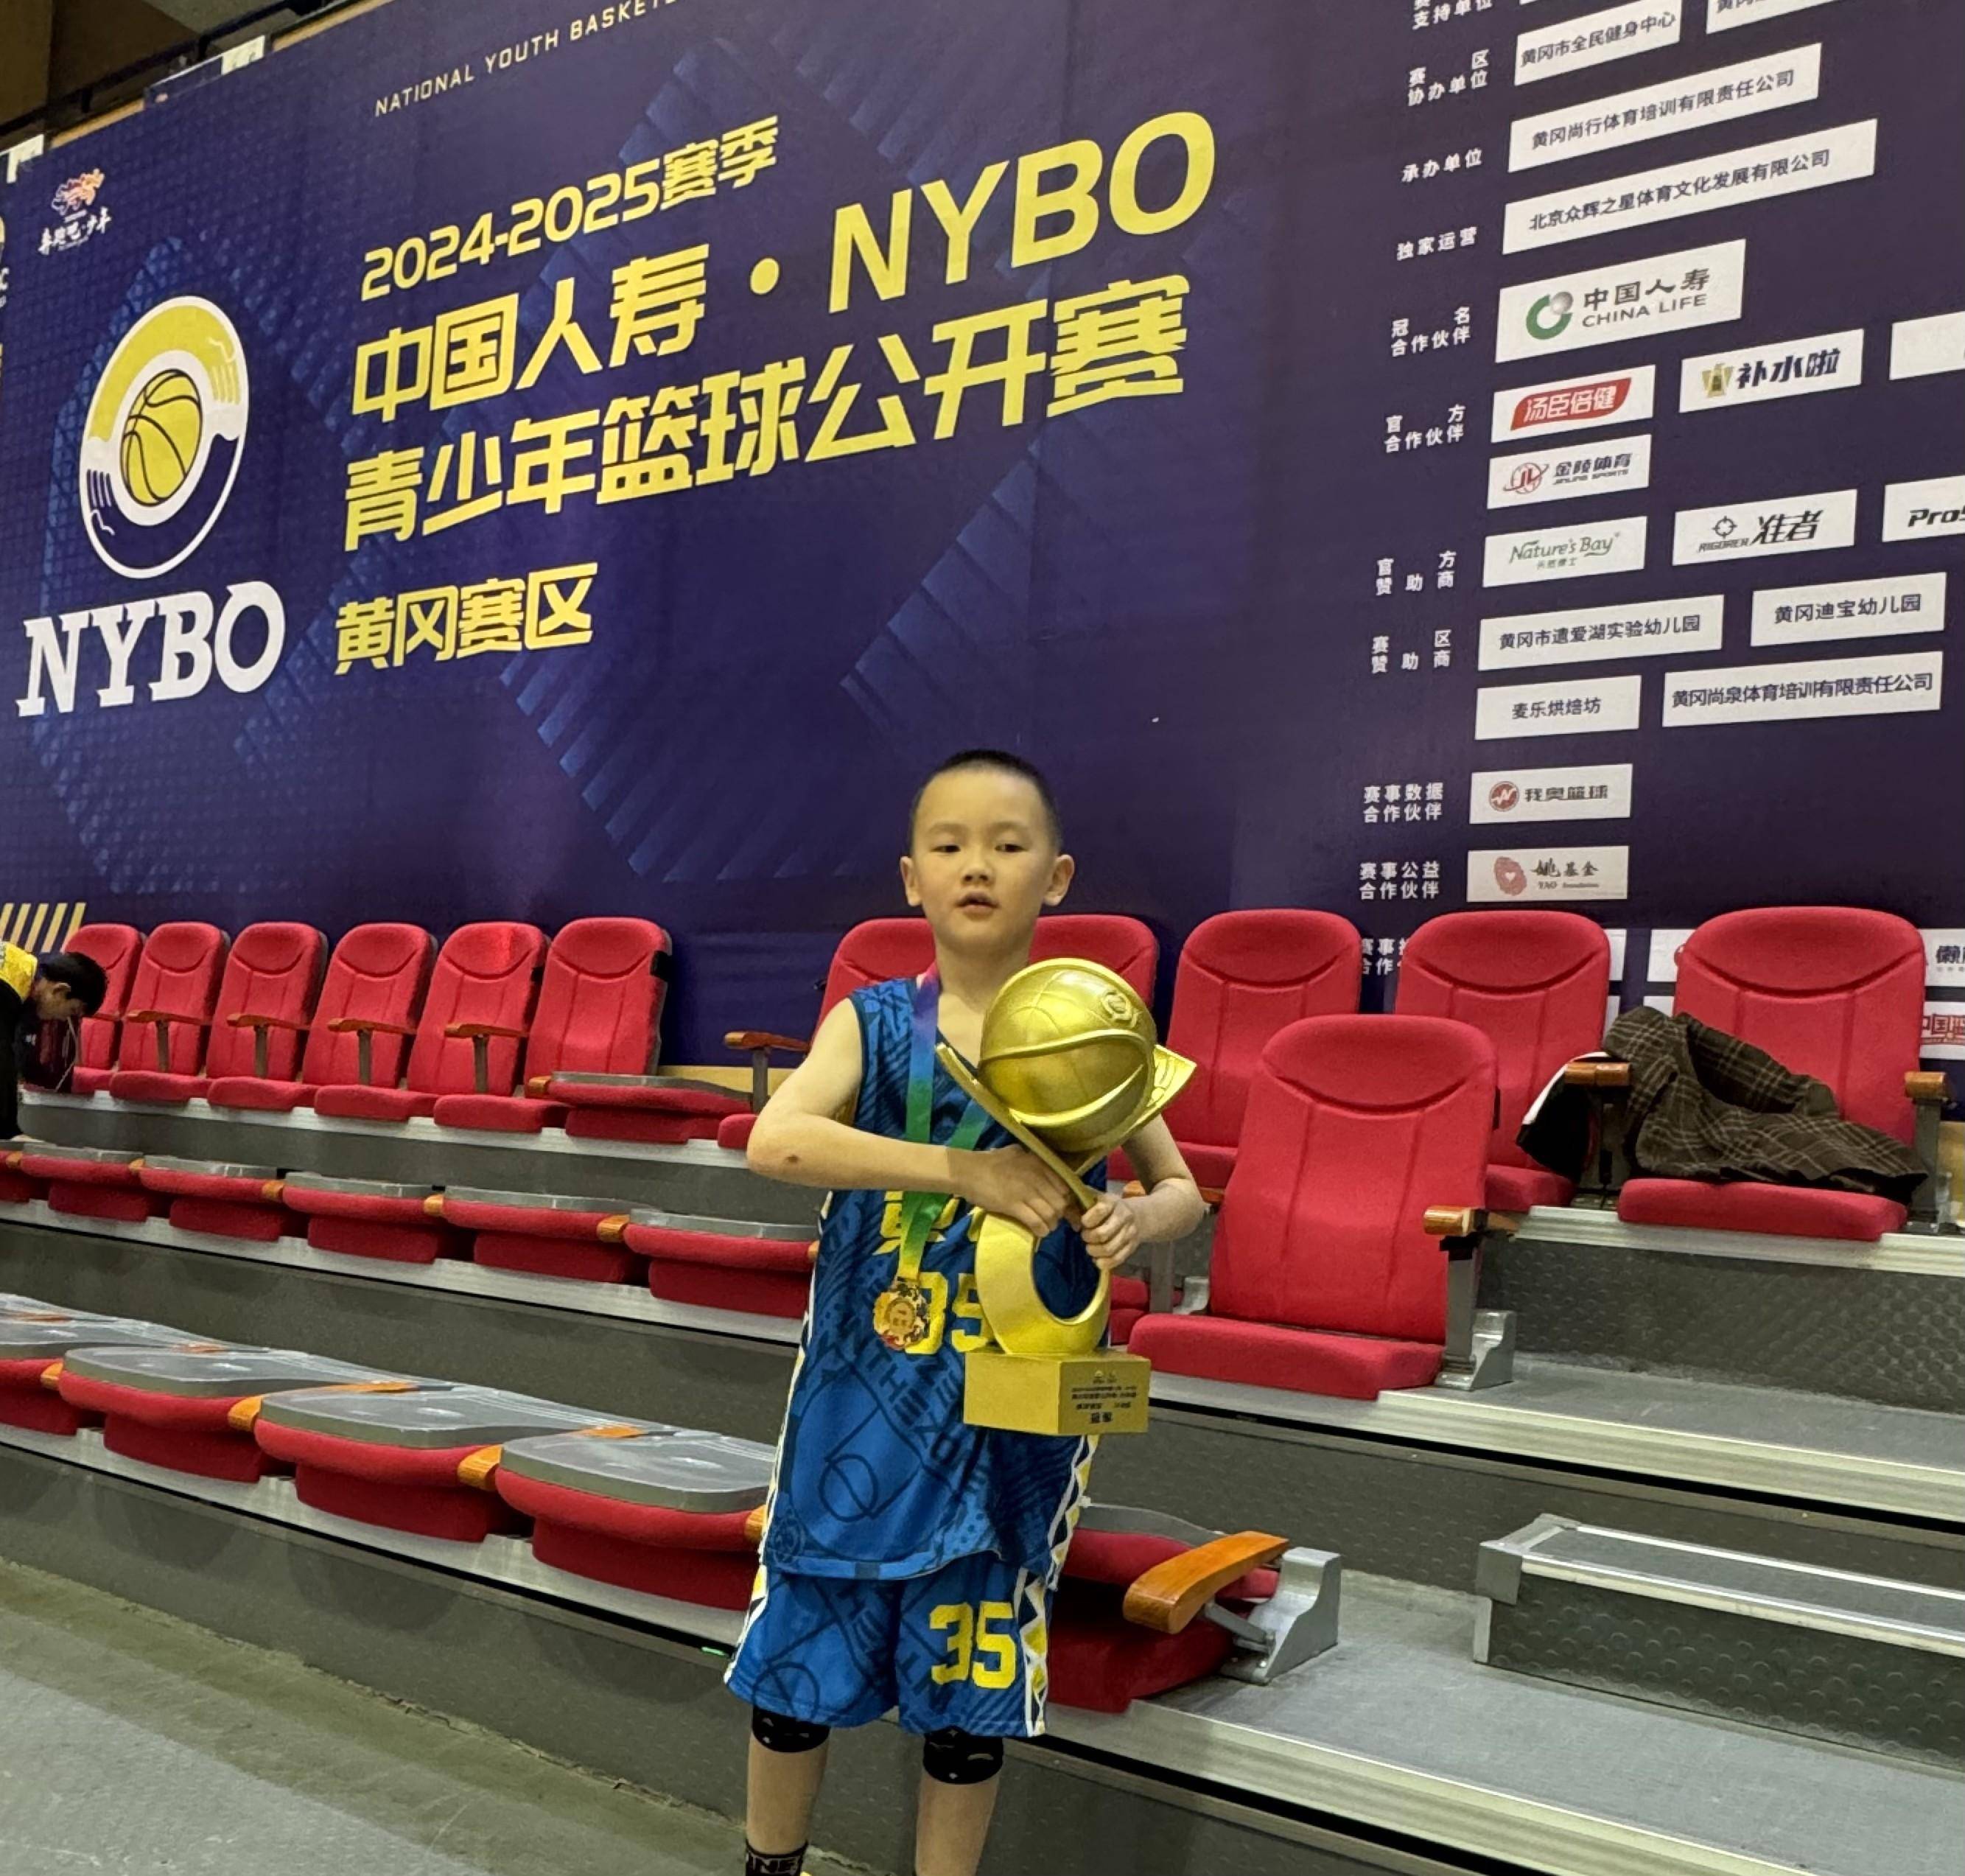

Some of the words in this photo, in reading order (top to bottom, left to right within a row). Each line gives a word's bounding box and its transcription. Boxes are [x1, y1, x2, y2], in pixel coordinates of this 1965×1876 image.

[1520, 10, 1676, 68] 黄冈市全民健身中心
[374, 64, 476, 117] NATIONAL
[484, 29, 560, 74] YOUTH
[570, 0, 676, 41] BASKE
[1407, 69, 1488, 107] 协办单位
[1532, 69, 1795, 150] 黄冈尚行体育培训有限责任公司
[1401, 147, 1482, 183] 承办单位
[1529, 148, 1831, 231] 北京众辉之星体育文化发展有限公司
[360, 115, 779, 301] 2024-2025赛季
[1396, 225, 1477, 262] 独家运营
[350, 243, 710, 424] 中国人寿
[829, 111, 1216, 313] NYBO
[1583, 267, 1711, 312] 中国人寿
[1582, 304, 1651, 329] CHINA
[1658, 293, 1709, 315] LIFE
[1390, 325, 1471, 357] 合作伙伴
[1736, 347, 1841, 390] 补水啦
[343, 274, 1191, 551] 青少年篮球公开赛
[1522, 384, 1619, 424] 汤臣倍健
[1383, 423, 1465, 454] 合作伙伴
[1554, 452, 1633, 478] 金陵体育
[1749, 510, 1824, 546] 准者
[1508, 539, 1577, 565] Nature's
[1376, 570, 1455, 596] 赞助商
[334, 562, 598, 675] 黄冈赛区
[1773, 593, 1922, 624] 黄冈迪宝幼儿园
[15, 580, 287, 718] NYBO
[1499, 614, 1700, 650] 黄冈市遗爱湖实验幼儿园
[1371, 650, 1451, 674] 赞助商
[1671, 672, 1934, 709] 黄冈尚泉体育培训有限责任公司
[1363, 782, 1444, 804] 赛事数据
[1524, 784, 1609, 802] 我奥篮球
[1362, 804, 1443, 824] 合作伙伴
[1359, 861, 1440, 881] 赛事公益
[1530, 857, 1600, 878] 姚基金
[1359, 881, 1440, 900] 合作伙伴
[929, 1601, 1016, 1689] 35
